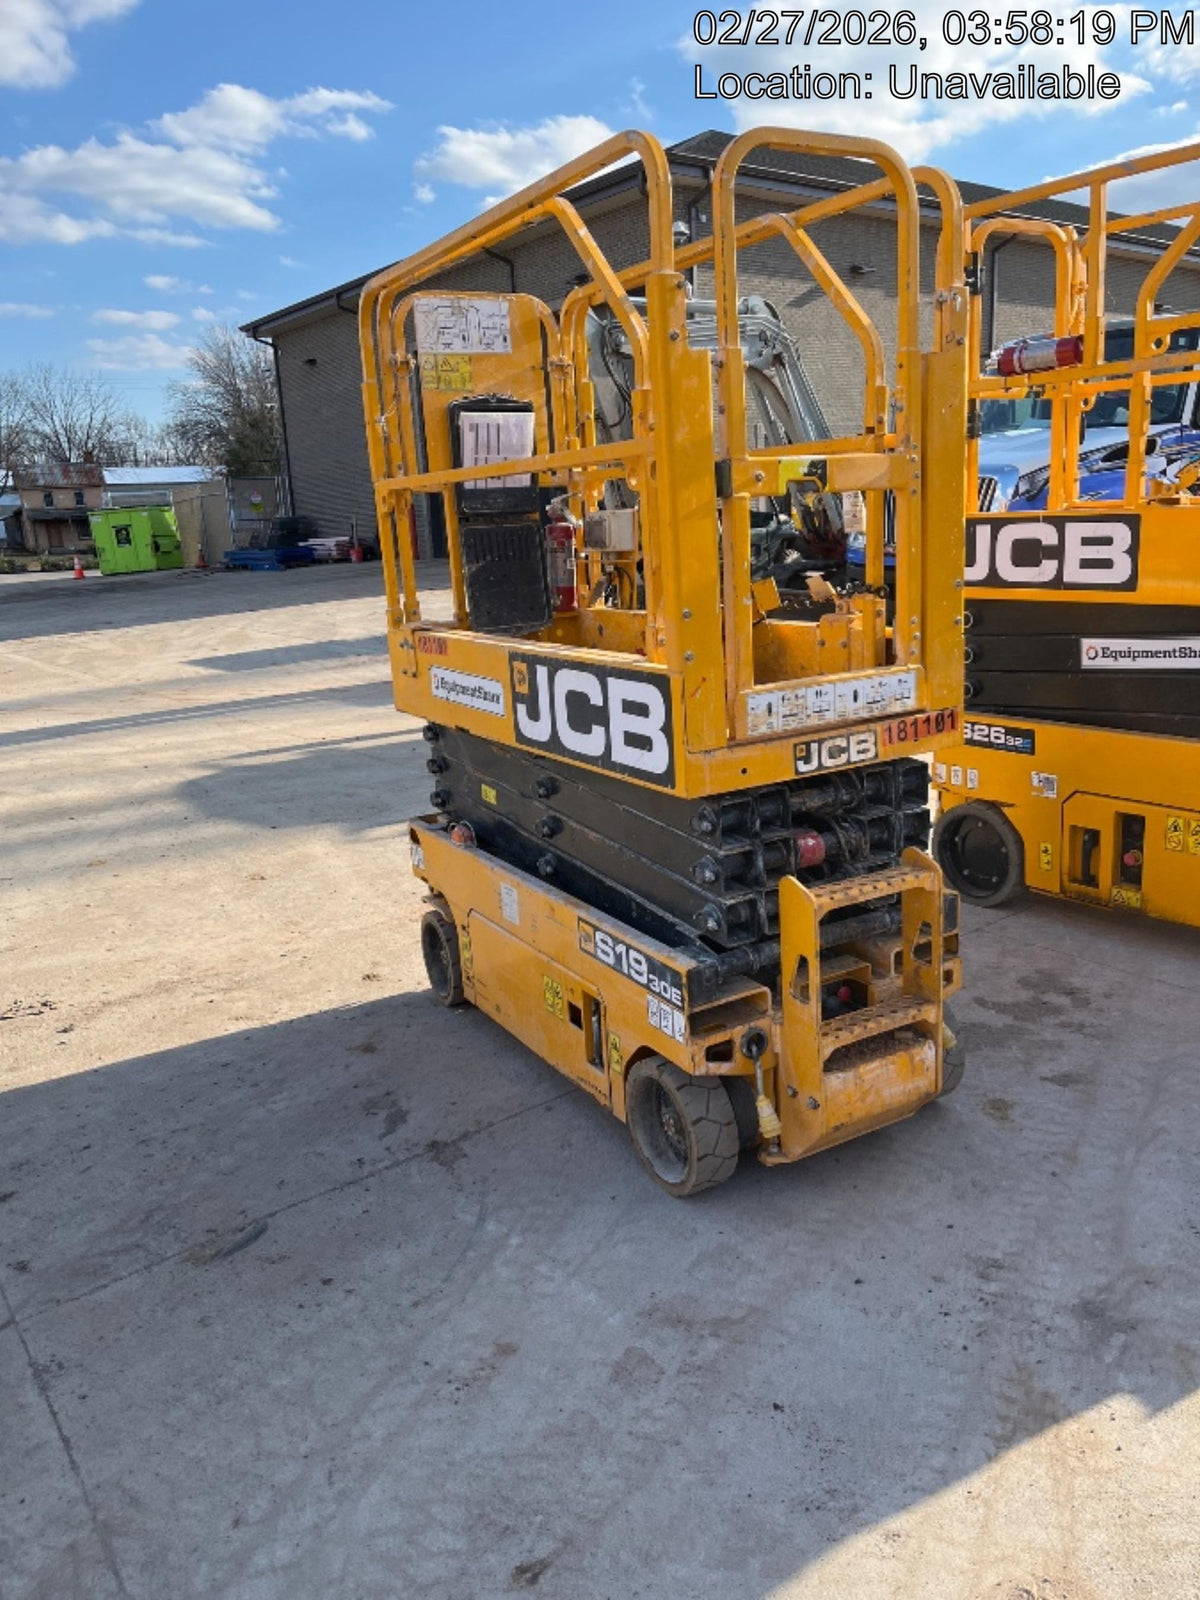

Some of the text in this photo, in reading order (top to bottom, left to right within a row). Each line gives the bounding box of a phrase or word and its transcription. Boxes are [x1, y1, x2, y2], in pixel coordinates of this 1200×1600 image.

[1100, 646, 1200, 661] EquipmentSh
[516, 664, 669, 774] JCB
[884, 709, 955, 744] 181101
[796, 732, 876, 772] JCB
